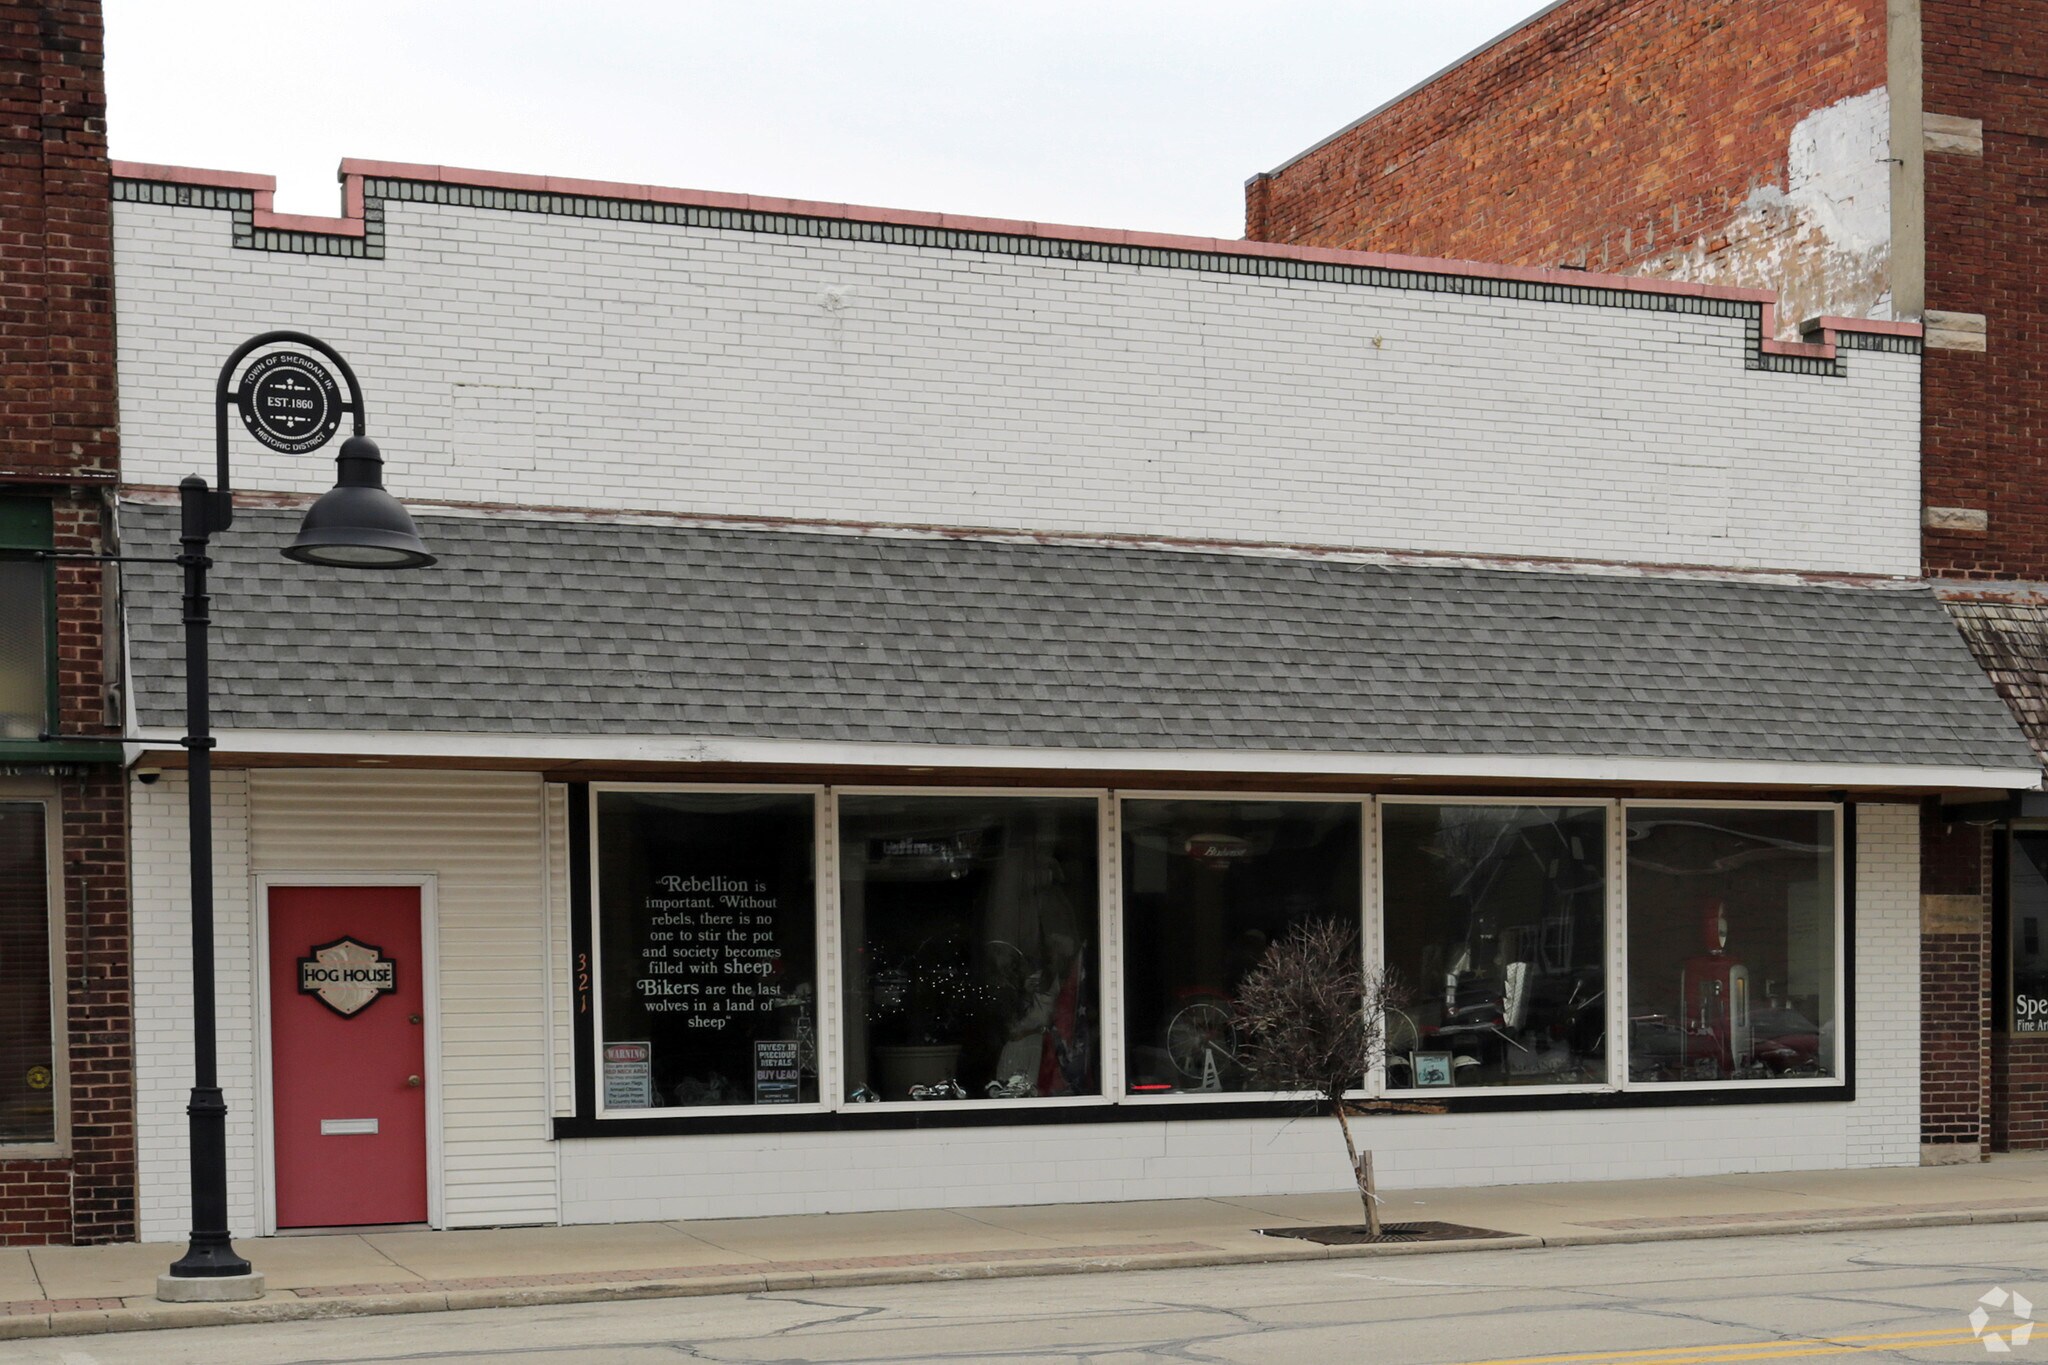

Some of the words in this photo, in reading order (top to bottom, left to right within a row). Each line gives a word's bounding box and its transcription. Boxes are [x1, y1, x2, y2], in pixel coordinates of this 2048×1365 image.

[245, 363, 266, 385] TOWN
[265, 356, 278, 366] OF
[255, 426, 291, 451] HISTORIC
[292, 431, 326, 451] DISTRICT
[755, 880, 767, 892] is
[645, 896, 715, 911] important.
[719, 895, 778, 909] Without
[652, 913, 695, 926] rebels,
[700, 912, 733, 925] there
[739, 912, 750, 925] is
[756, 916, 773, 925] no
[650, 932, 674, 941] one
[680, 930, 692, 941] to
[698, 929, 721, 941] stir
[726, 929, 747, 941] the
[753, 931, 774, 943] pot
[642, 945, 667, 958] and
[673, 945, 719, 960] society
[724, 945, 782, 958] becomes
[649, 961, 683, 974] filled
[689, 961, 718, 974] with
[723, 958, 776, 977] sheep.
[304, 969, 340, 982] HOG
[343, 969, 391, 982] HOUSE
[576, 953, 589, 1013] 321
[636, 979, 700, 996] Bikers
[705, 985, 726, 995] are
[732, 982, 752, 995] the
[757, 982, 781, 995] last
[645, 999, 689, 1012] wolves
[693, 999, 707, 1011] in
[712, 1001, 721, 1012] a
[726, 999, 755, 1012] land
[760, 998, 774, 1012] of
[2017, 1019, 2035, 1032] Fine
[606, 1049, 646, 1059] WARNING
[759, 1051, 796, 1059] PRECIOUS
[757, 1071, 775, 1080] BUY
[776, 1070, 798, 1080] LEAD
